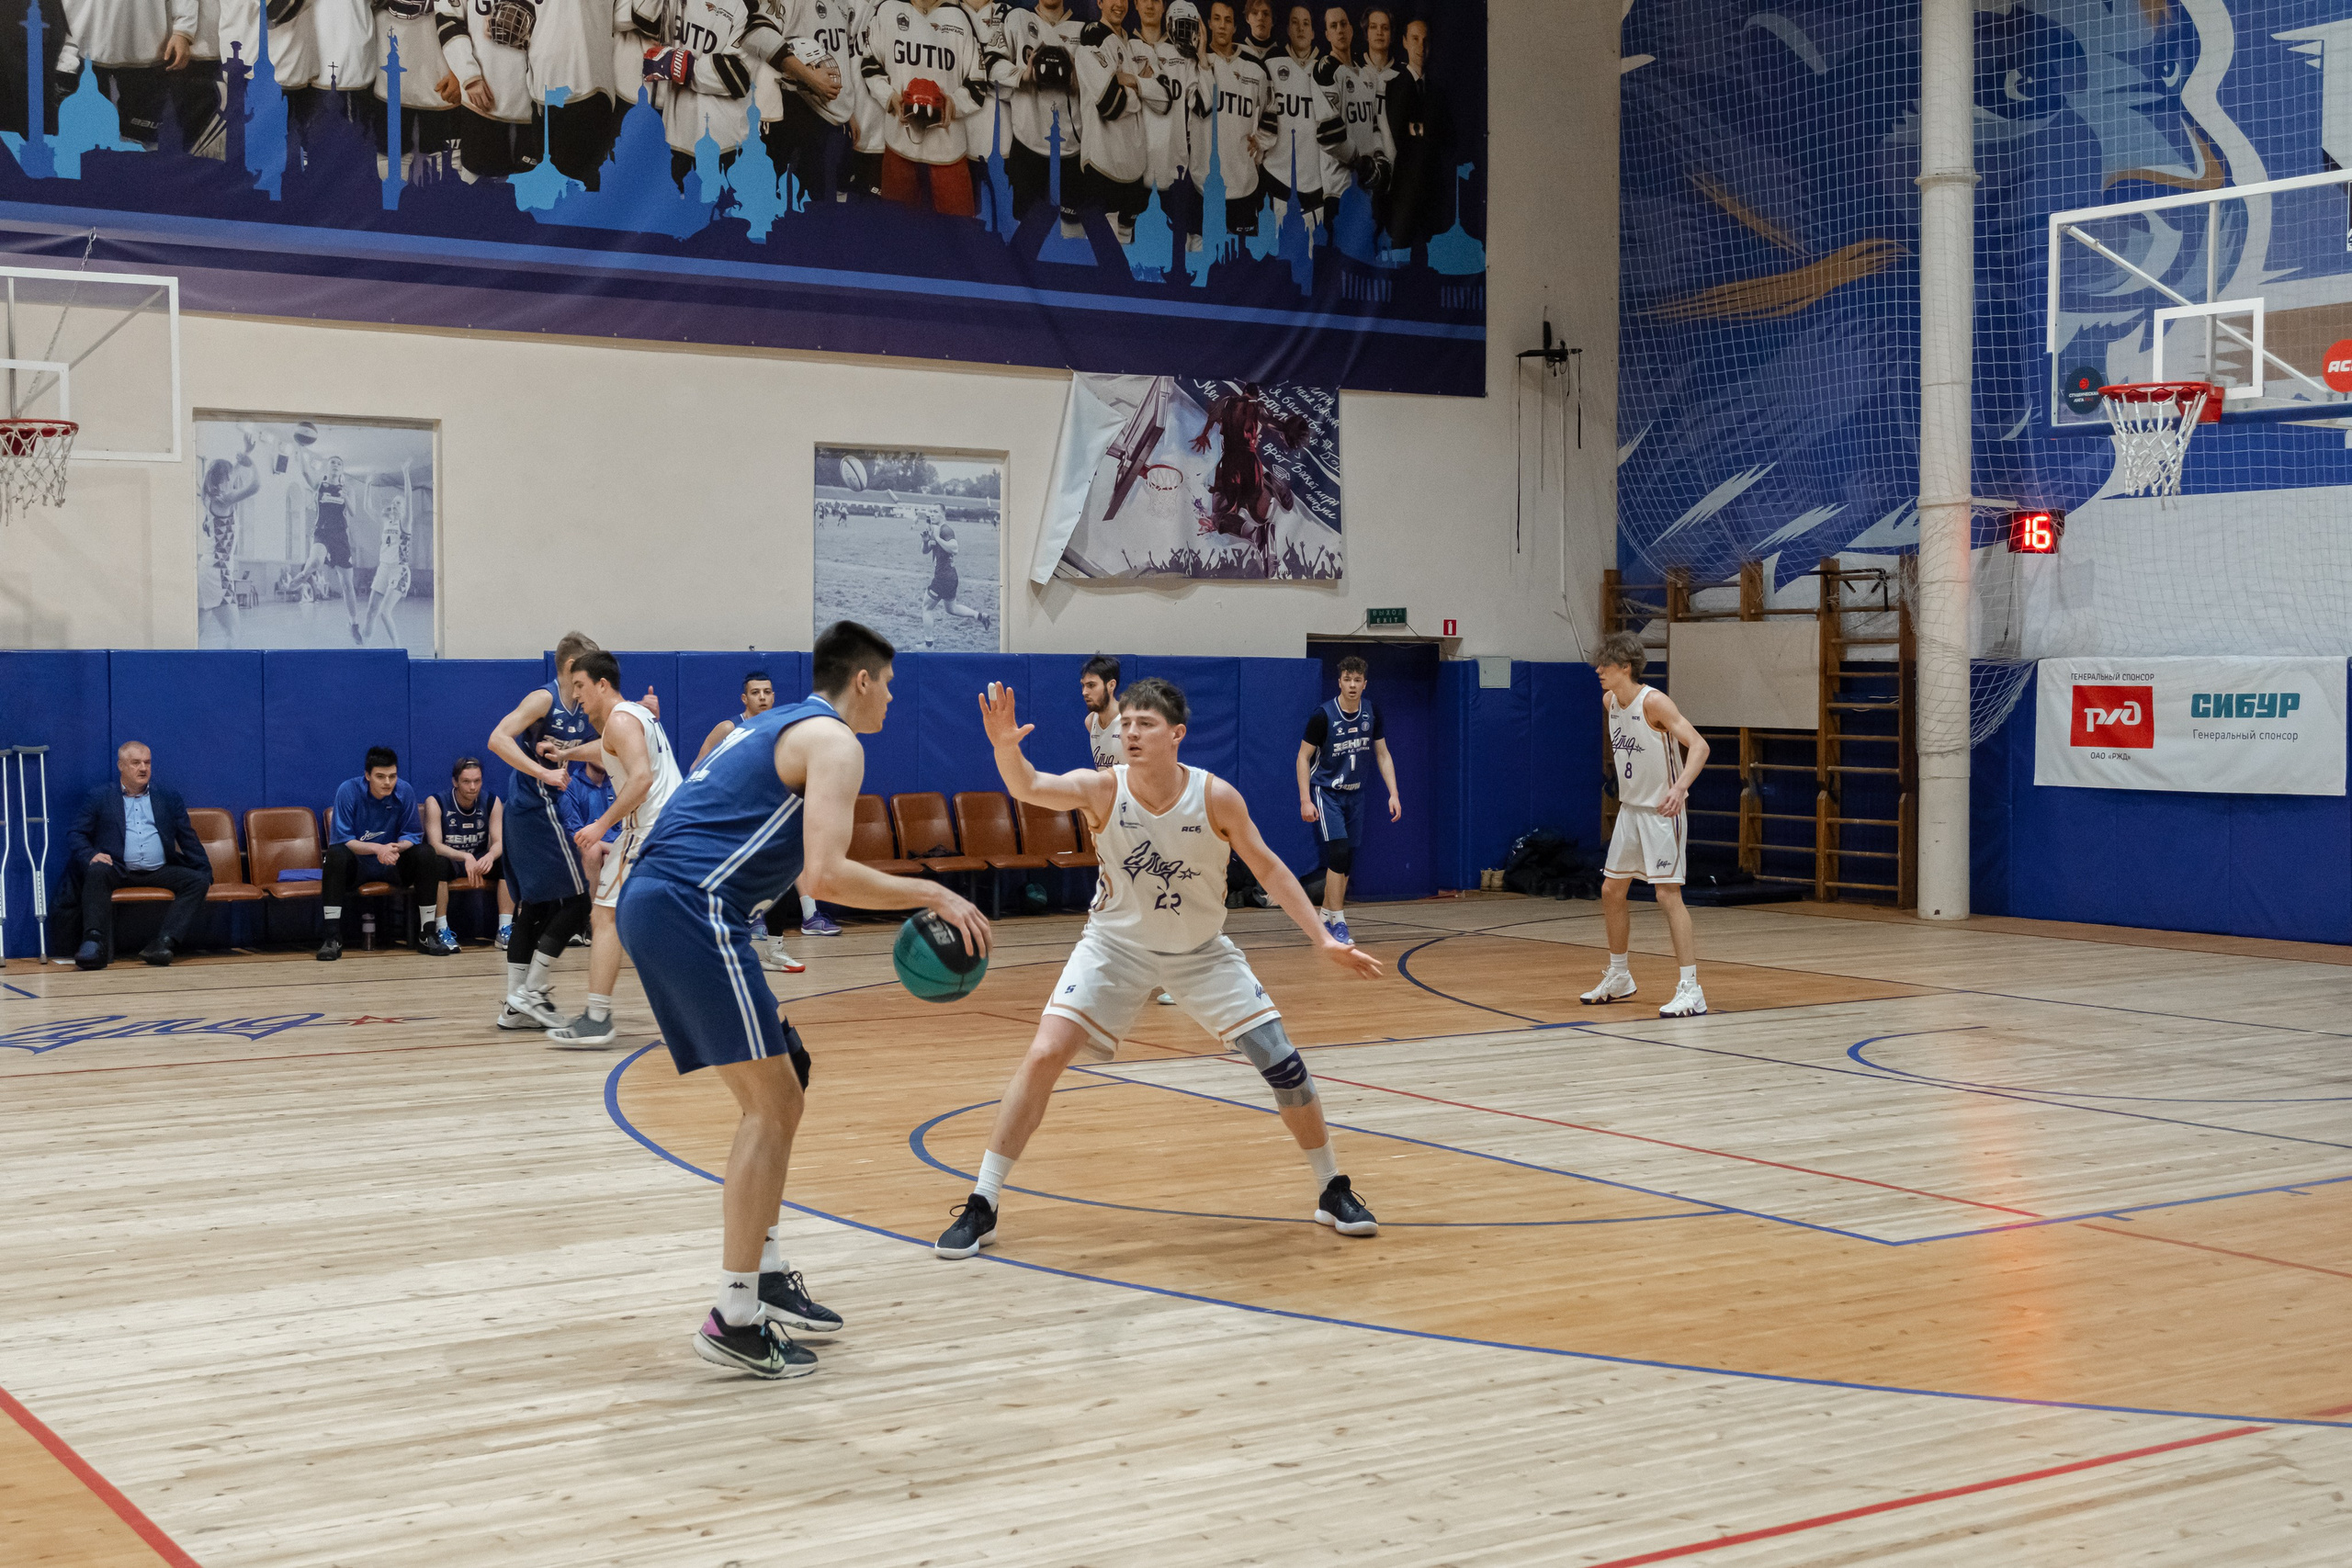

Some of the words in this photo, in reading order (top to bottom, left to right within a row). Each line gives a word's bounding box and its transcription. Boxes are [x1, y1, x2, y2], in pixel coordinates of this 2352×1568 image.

[894, 39, 956, 72] GUTID
[2025, 516, 2050, 548] 16
[2071, 672, 2120, 681] ГЕНЕРАЛЬНЫЙ
[2122, 672, 2154, 681] СПОНСОР
[2190, 693, 2301, 718] СИБУР
[2192, 728, 2256, 742] Генеральный
[2259, 731, 2299, 742] спонсор
[1333, 737, 1370, 752] ЗЕНИТ
[1350, 754, 1356, 771] 1
[1624, 761, 1633, 779] 8
